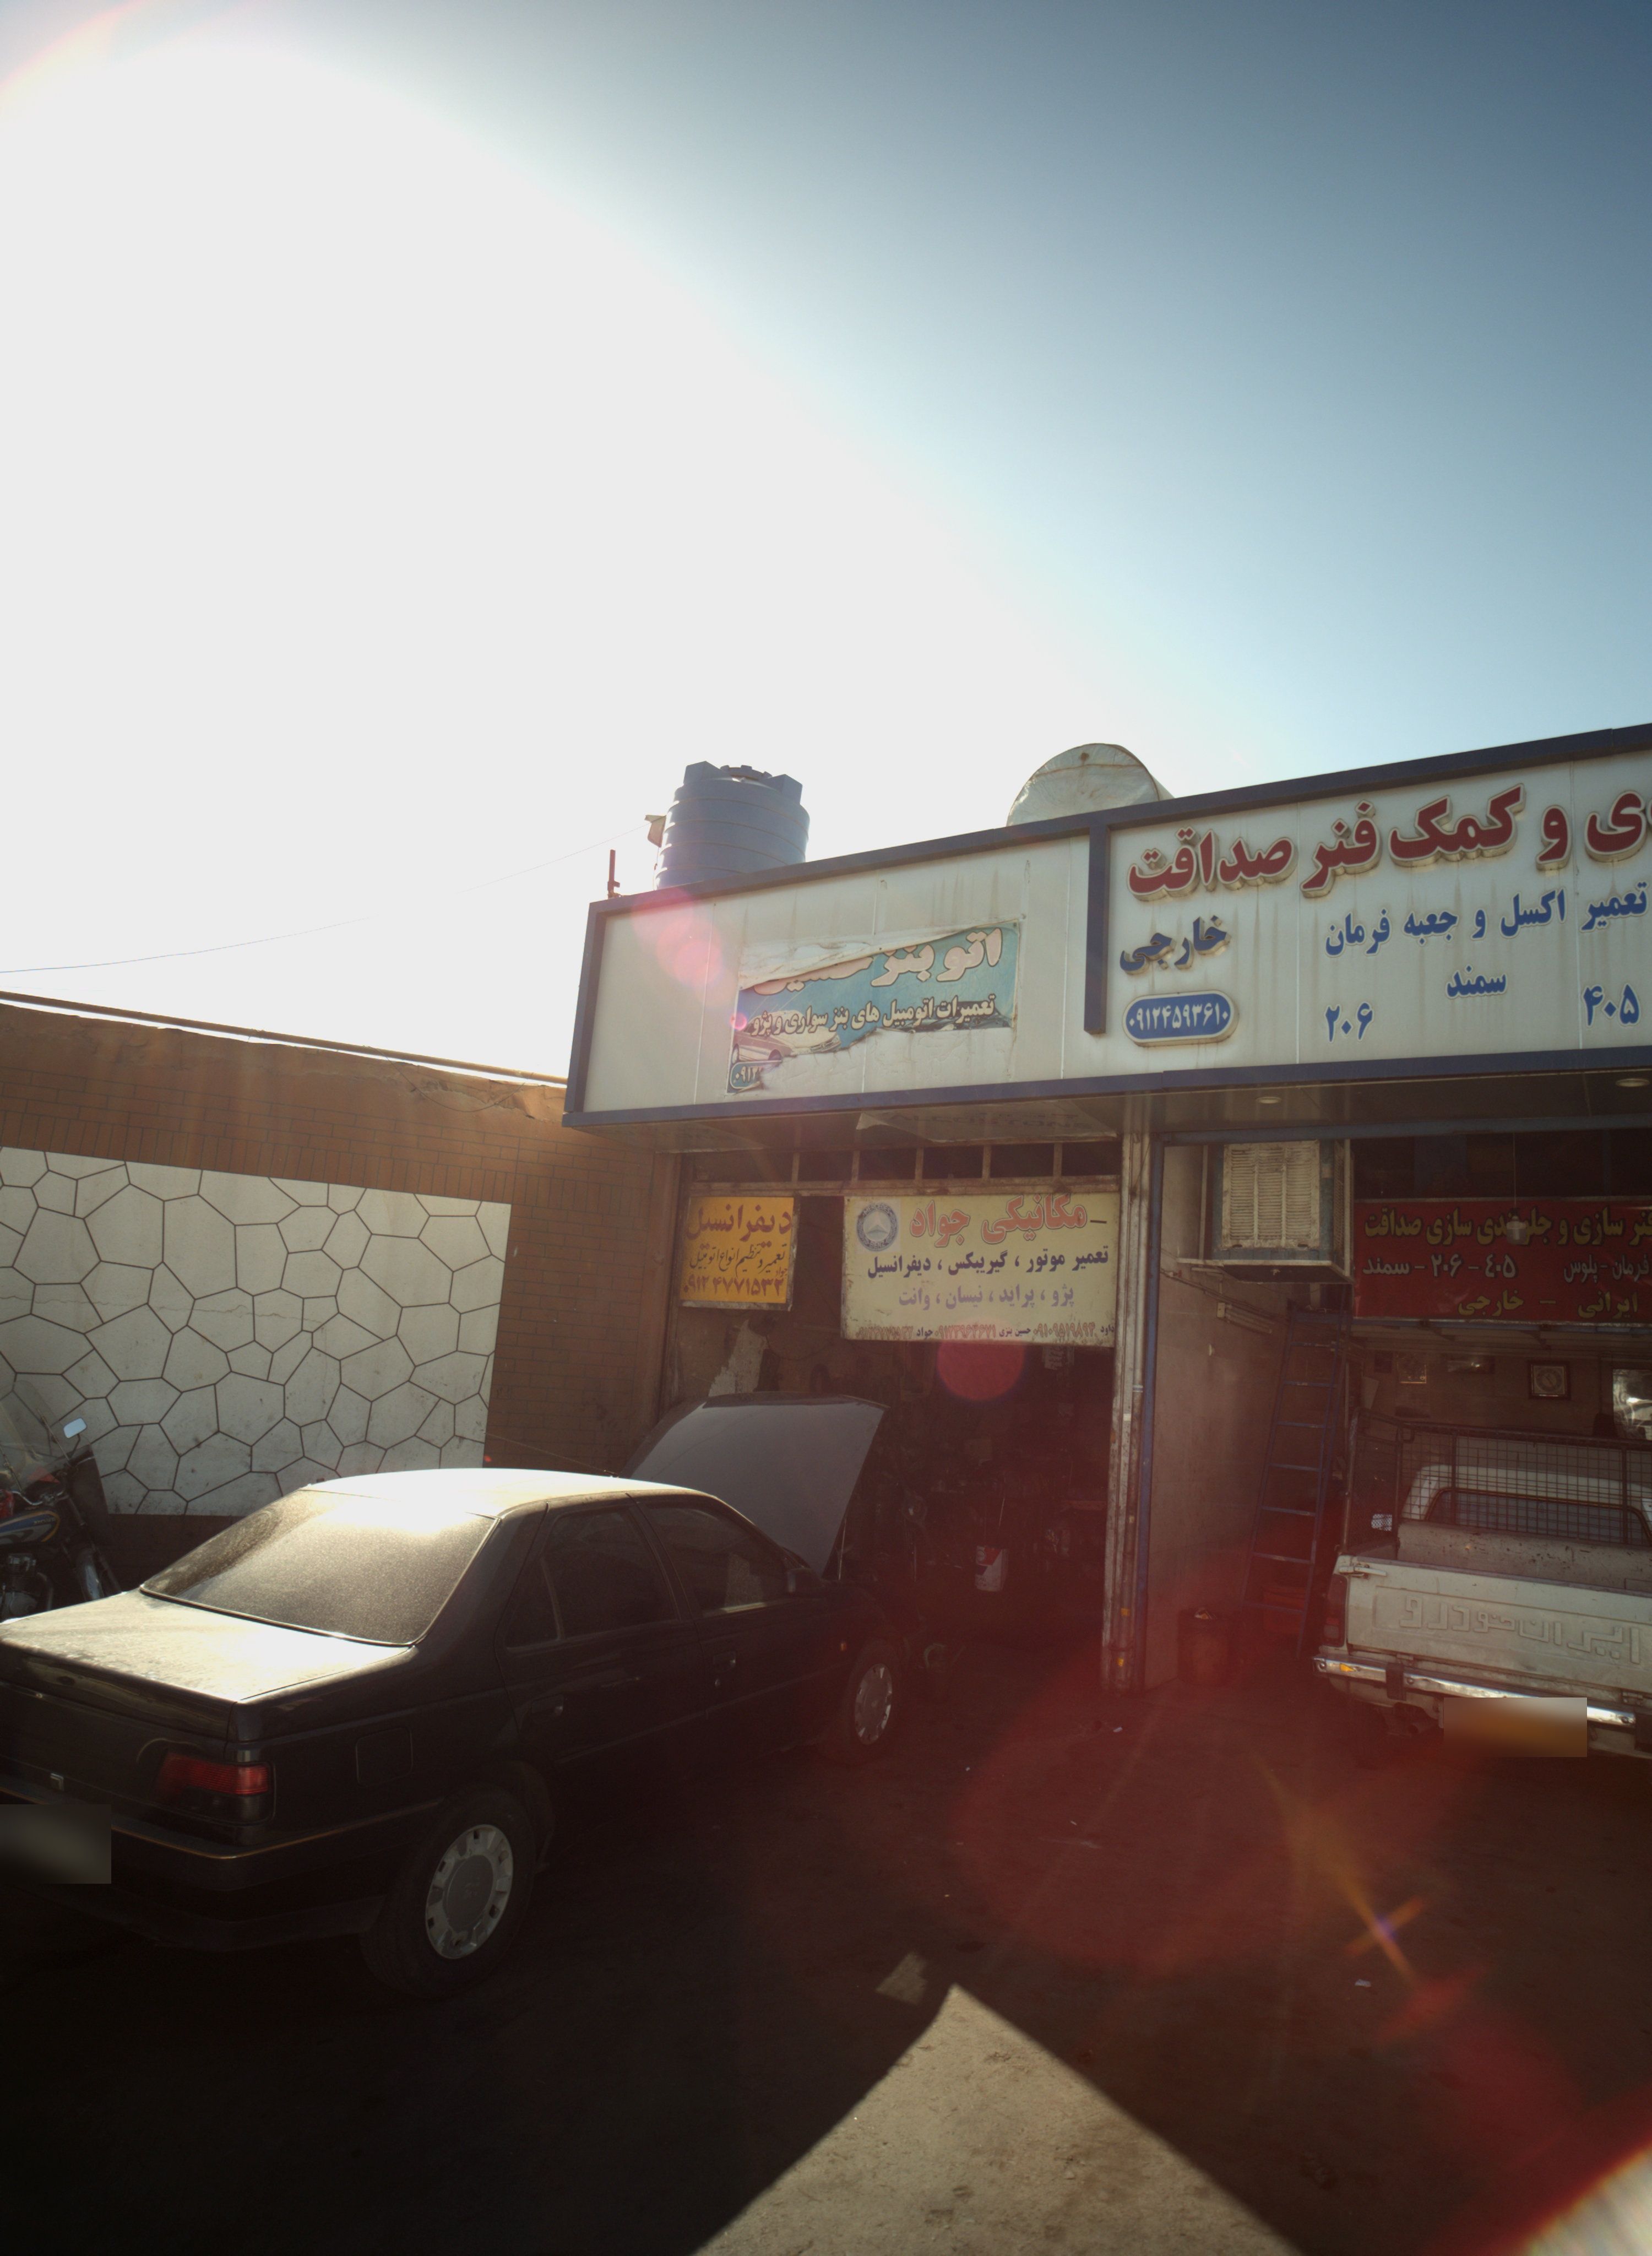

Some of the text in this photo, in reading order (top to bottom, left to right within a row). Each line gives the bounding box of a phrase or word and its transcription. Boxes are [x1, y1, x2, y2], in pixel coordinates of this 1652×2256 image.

[1389, 783, 1525, 866] کمک
[1536, 804, 1572, 869] و
[1301, 800, 1382, 897] فنر
[1127, 827, 1298, 900] صداقت
[1325, 882, 1648, 957] تعمیر اکسل و جعبه فرمان
[936, 928, 1002, 982] اتو
[1120, 915, 1231, 975] خارجی
[1447, 966, 1507, 997] سمند
[751, 993, 996, 1036] تعمیرات اتومبیل های بنز سواری و پژو
[1129, 1002, 1229, 1031] ۰۹۱۲۴۵۹۳۶۱۰
[1583, 985, 1640, 1027] ۴۰۵
[1325, 1003, 1373, 1042] ۲۰۶
[735, 1066, 763, 1083] ۰۹۱۲
[910, 1192, 1087, 1248] مکانیکی جواد
[1364, 1207, 1422, 1237] صداقت
[1426, 1206, 1472, 1245] سازی
[1557, 1216, 1569, 1245] و
[1573, 1206, 1624, 1246] سازی
[719, 1248, 740, 1272] انواع
[758, 1243, 787, 1274] تعمیر
[868, 1255, 931, 1278] دیفرانسیل
[1026, 1249, 1065, 1272] موتور
[1072, 1245, 1108, 1271] تعمیر
[1363, 1257, 1410, 1276] سمند
[1563, 1254, 1597, 1283] پلوس
[1612, 1254, 1650, 1283] فرمان
[899, 1287, 931, 1311] وانت
[945, 1285, 983, 1309] نیسان
[999, 1284, 1034, 1308] پراید
[1051, 1284, 1074, 1308] پژو
[1458, 1289, 1524, 1316] خارجی
[1578, 1290, 1638, 1319] ایرانی
[916, 1326, 933, 1340] جواد
